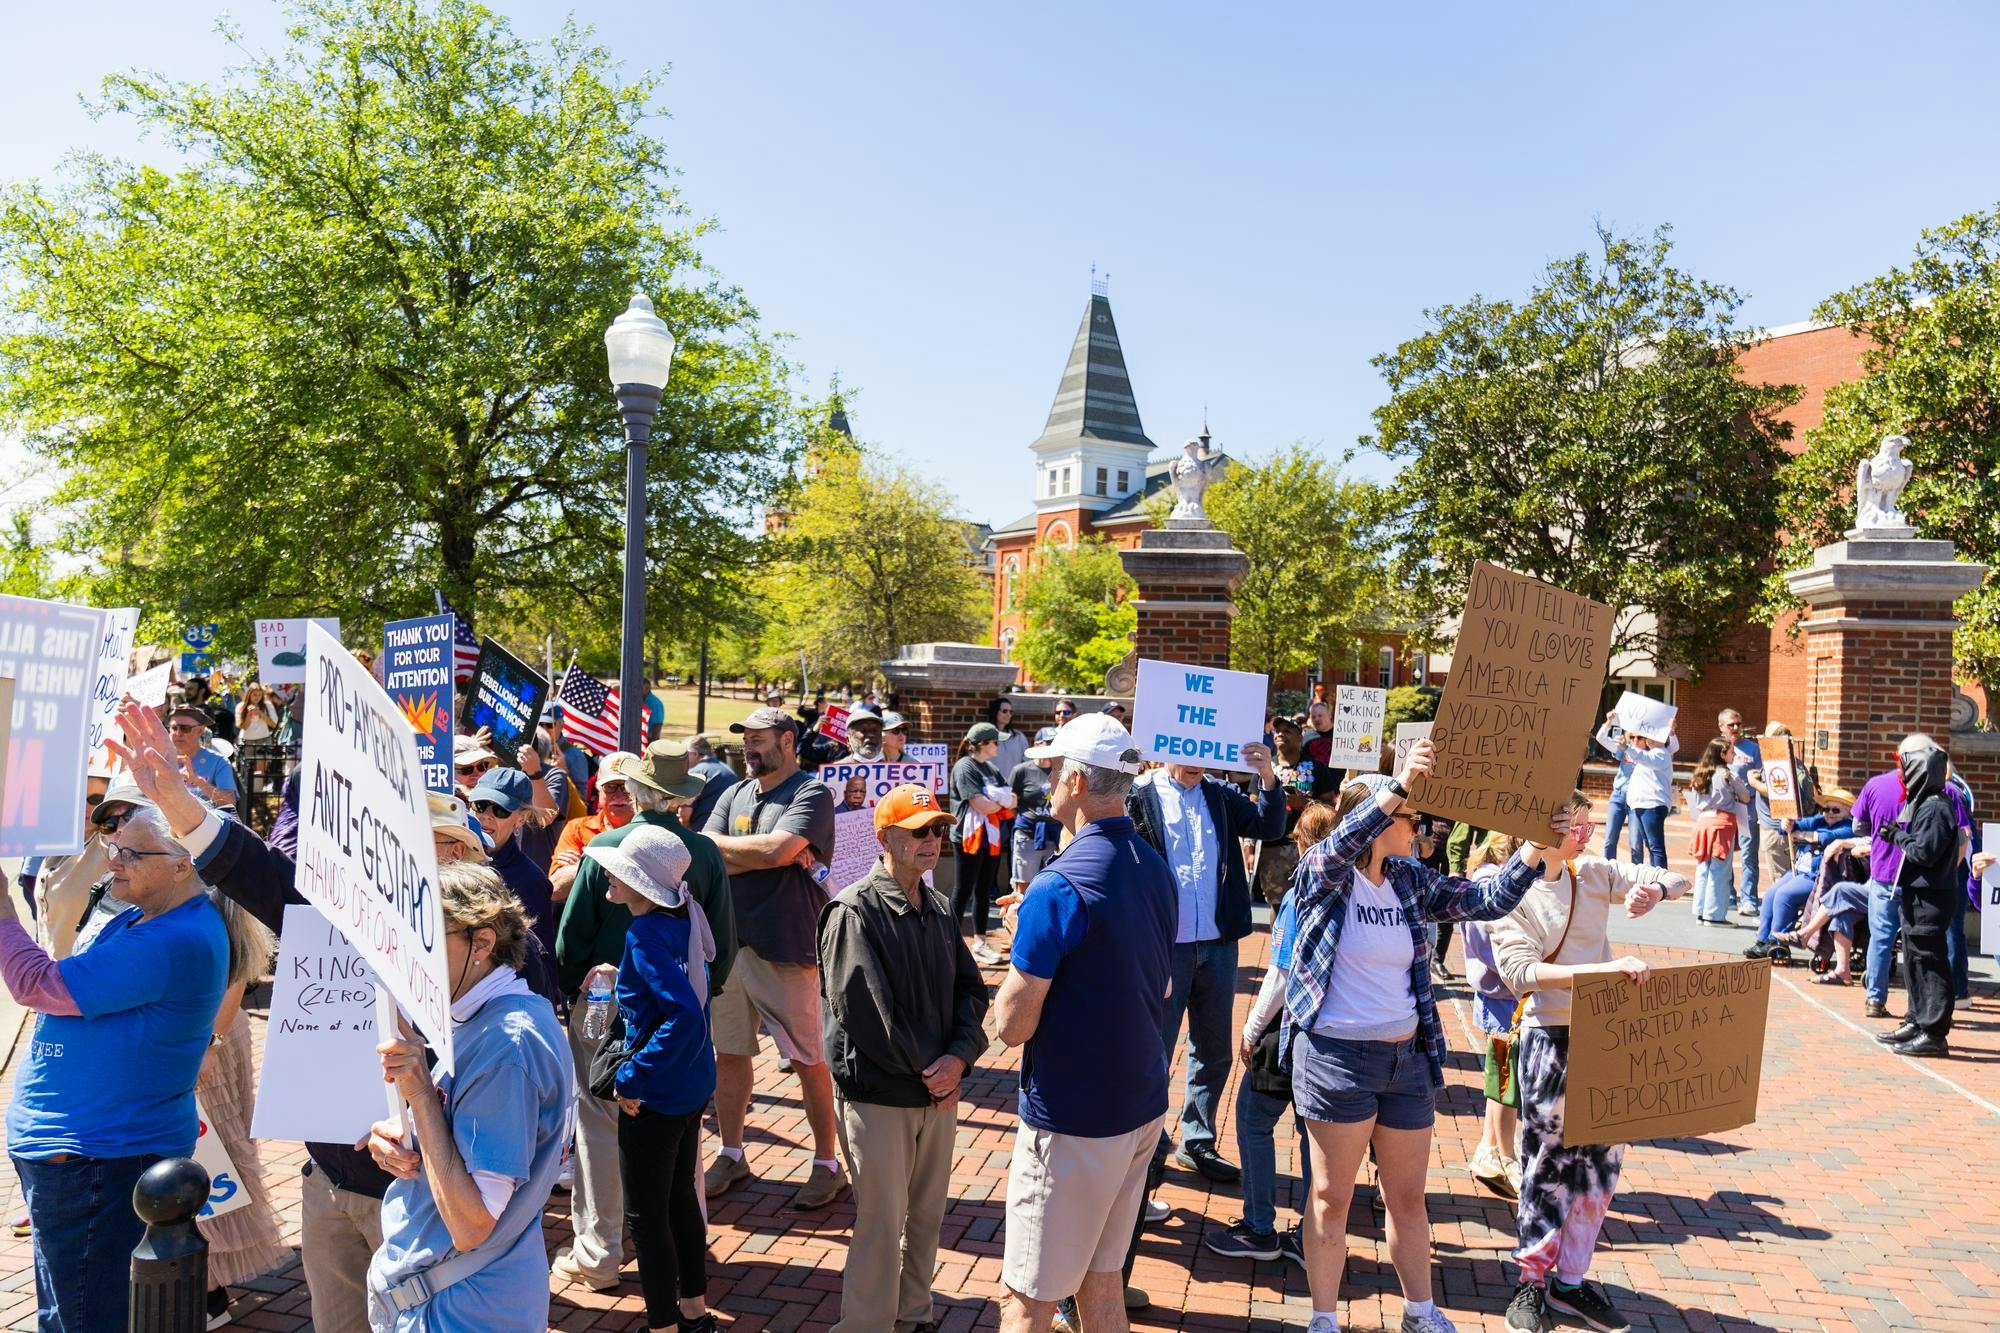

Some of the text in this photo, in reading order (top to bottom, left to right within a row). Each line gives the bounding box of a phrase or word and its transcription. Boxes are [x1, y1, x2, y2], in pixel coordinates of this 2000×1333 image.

[1472, 567, 1599, 634] DON'T TELL ME
[187, 625, 214, 643] 85
[260, 622, 285, 633] BAD
[264, 636, 288, 647] FIT
[387, 622, 450, 648] THANK YOU
[1483, 615, 1595, 670] YOU LOVE
[394, 647, 441, 667] FOR YOUR
[387, 667, 449, 690] ATTENTION
[1185, 672, 1215, 695] WE
[1457, 654, 1582, 705] AMERICA IF
[480, 671, 533, 720] REBELLIONS ARE
[1341, 689, 1379, 702] WE ARE
[437, 706, 450, 725] NO
[478, 687, 526, 733] BUILT ON HOPE
[1177, 704, 1218, 727] THE
[1449, 701, 1552, 737] YOU DON'T
[319, 654, 415, 815] PRO-AMERICA
[1336, 720, 1374, 733] SICK OF
[1154, 734, 1239, 763] PEOPLE
[1334, 737, 1355, 750] THIS
[1432, 727, 1547, 760] BELIEVE IN
[823, 764, 933, 783] PROTECT
[1431, 757, 1519, 785] LIBERTY
[1412, 779, 1558, 824] JUSTICE FOR ALL
[311, 757, 435, 954] ANTI-GESTAPO
[303, 841, 347, 910] HANDS
[351, 883, 374, 938] OFF
[373, 911, 401, 972] OUR
[294, 954, 375, 981] KING
[1577, 961, 1768, 1017] THE HOLOCAUST
[280, 1018, 372, 1034] None at all
[1601, 1003, 1735, 1052] STARTED AS A
[1629, 1041, 1703, 1083] MASS
[1586, 1054, 1750, 1123] DEPORTATION
